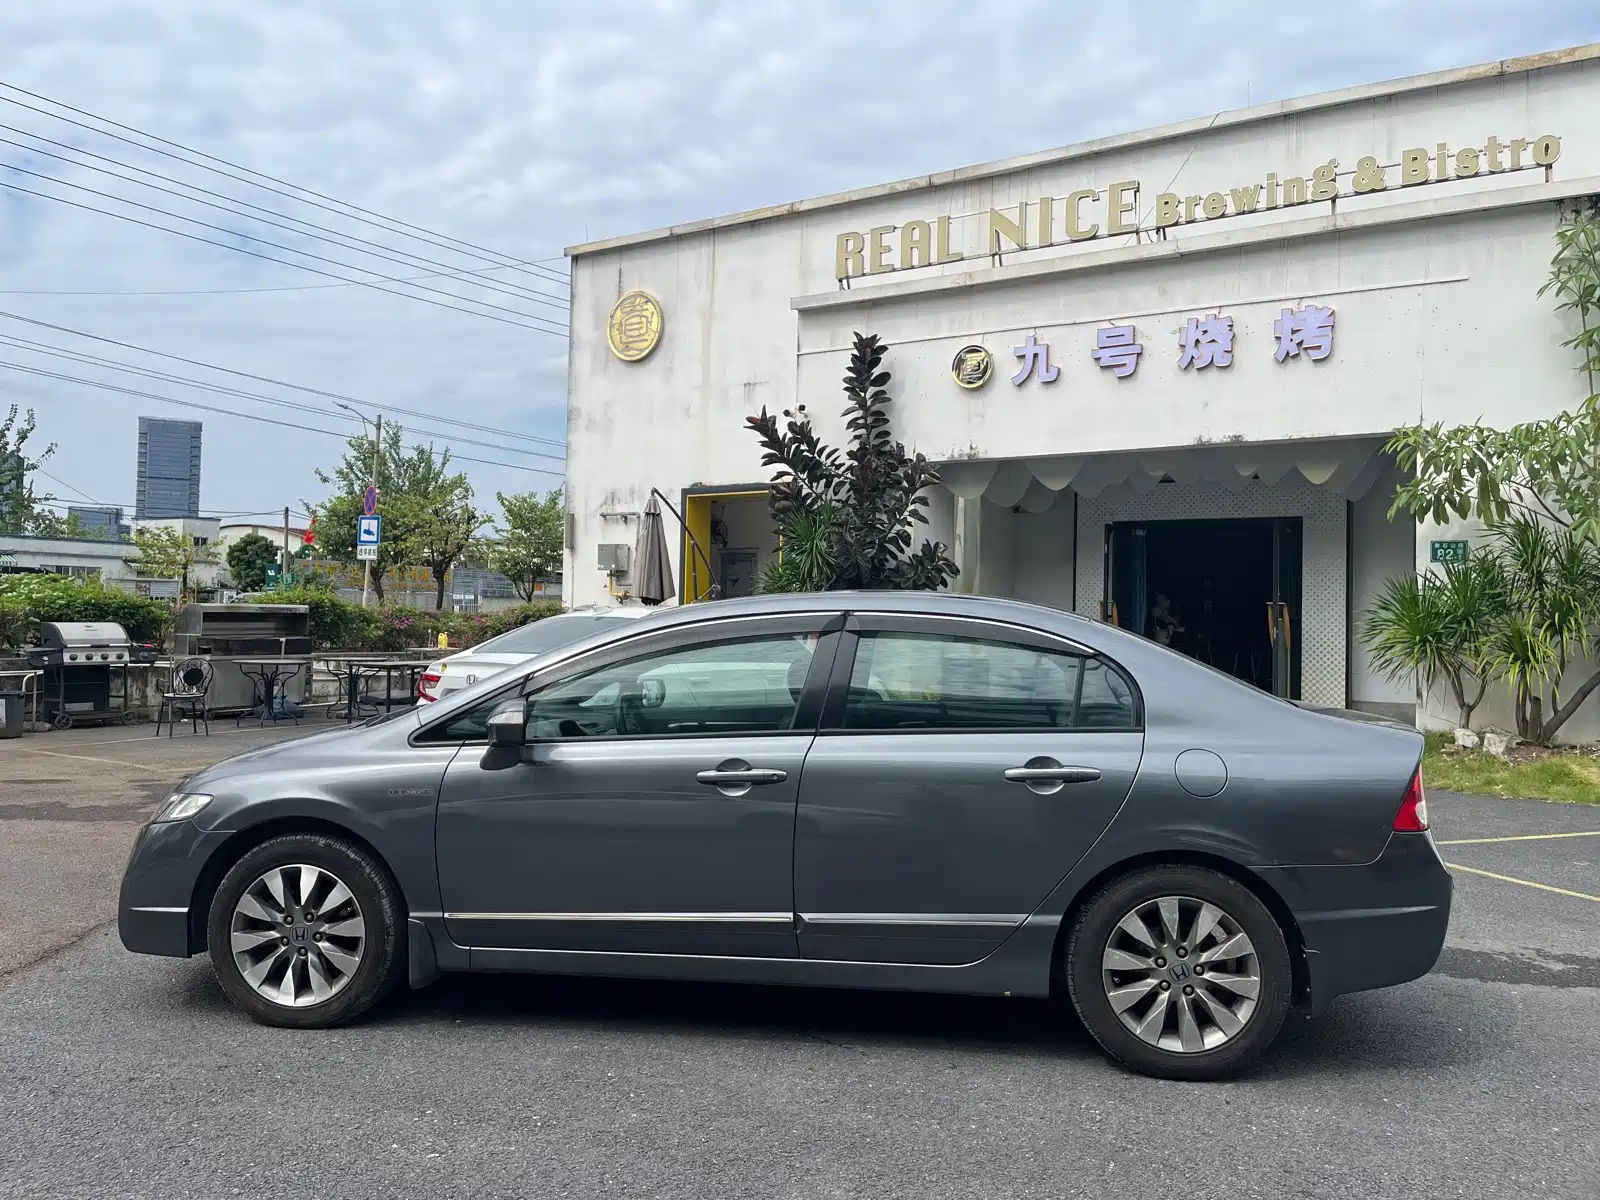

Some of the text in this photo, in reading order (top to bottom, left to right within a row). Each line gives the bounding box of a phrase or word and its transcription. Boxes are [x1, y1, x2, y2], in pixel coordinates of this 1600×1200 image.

[836, 133, 1562, 280] REAL NICE Brewing & Bistro
[1010, 304, 1336, 387] 九号烧烤
